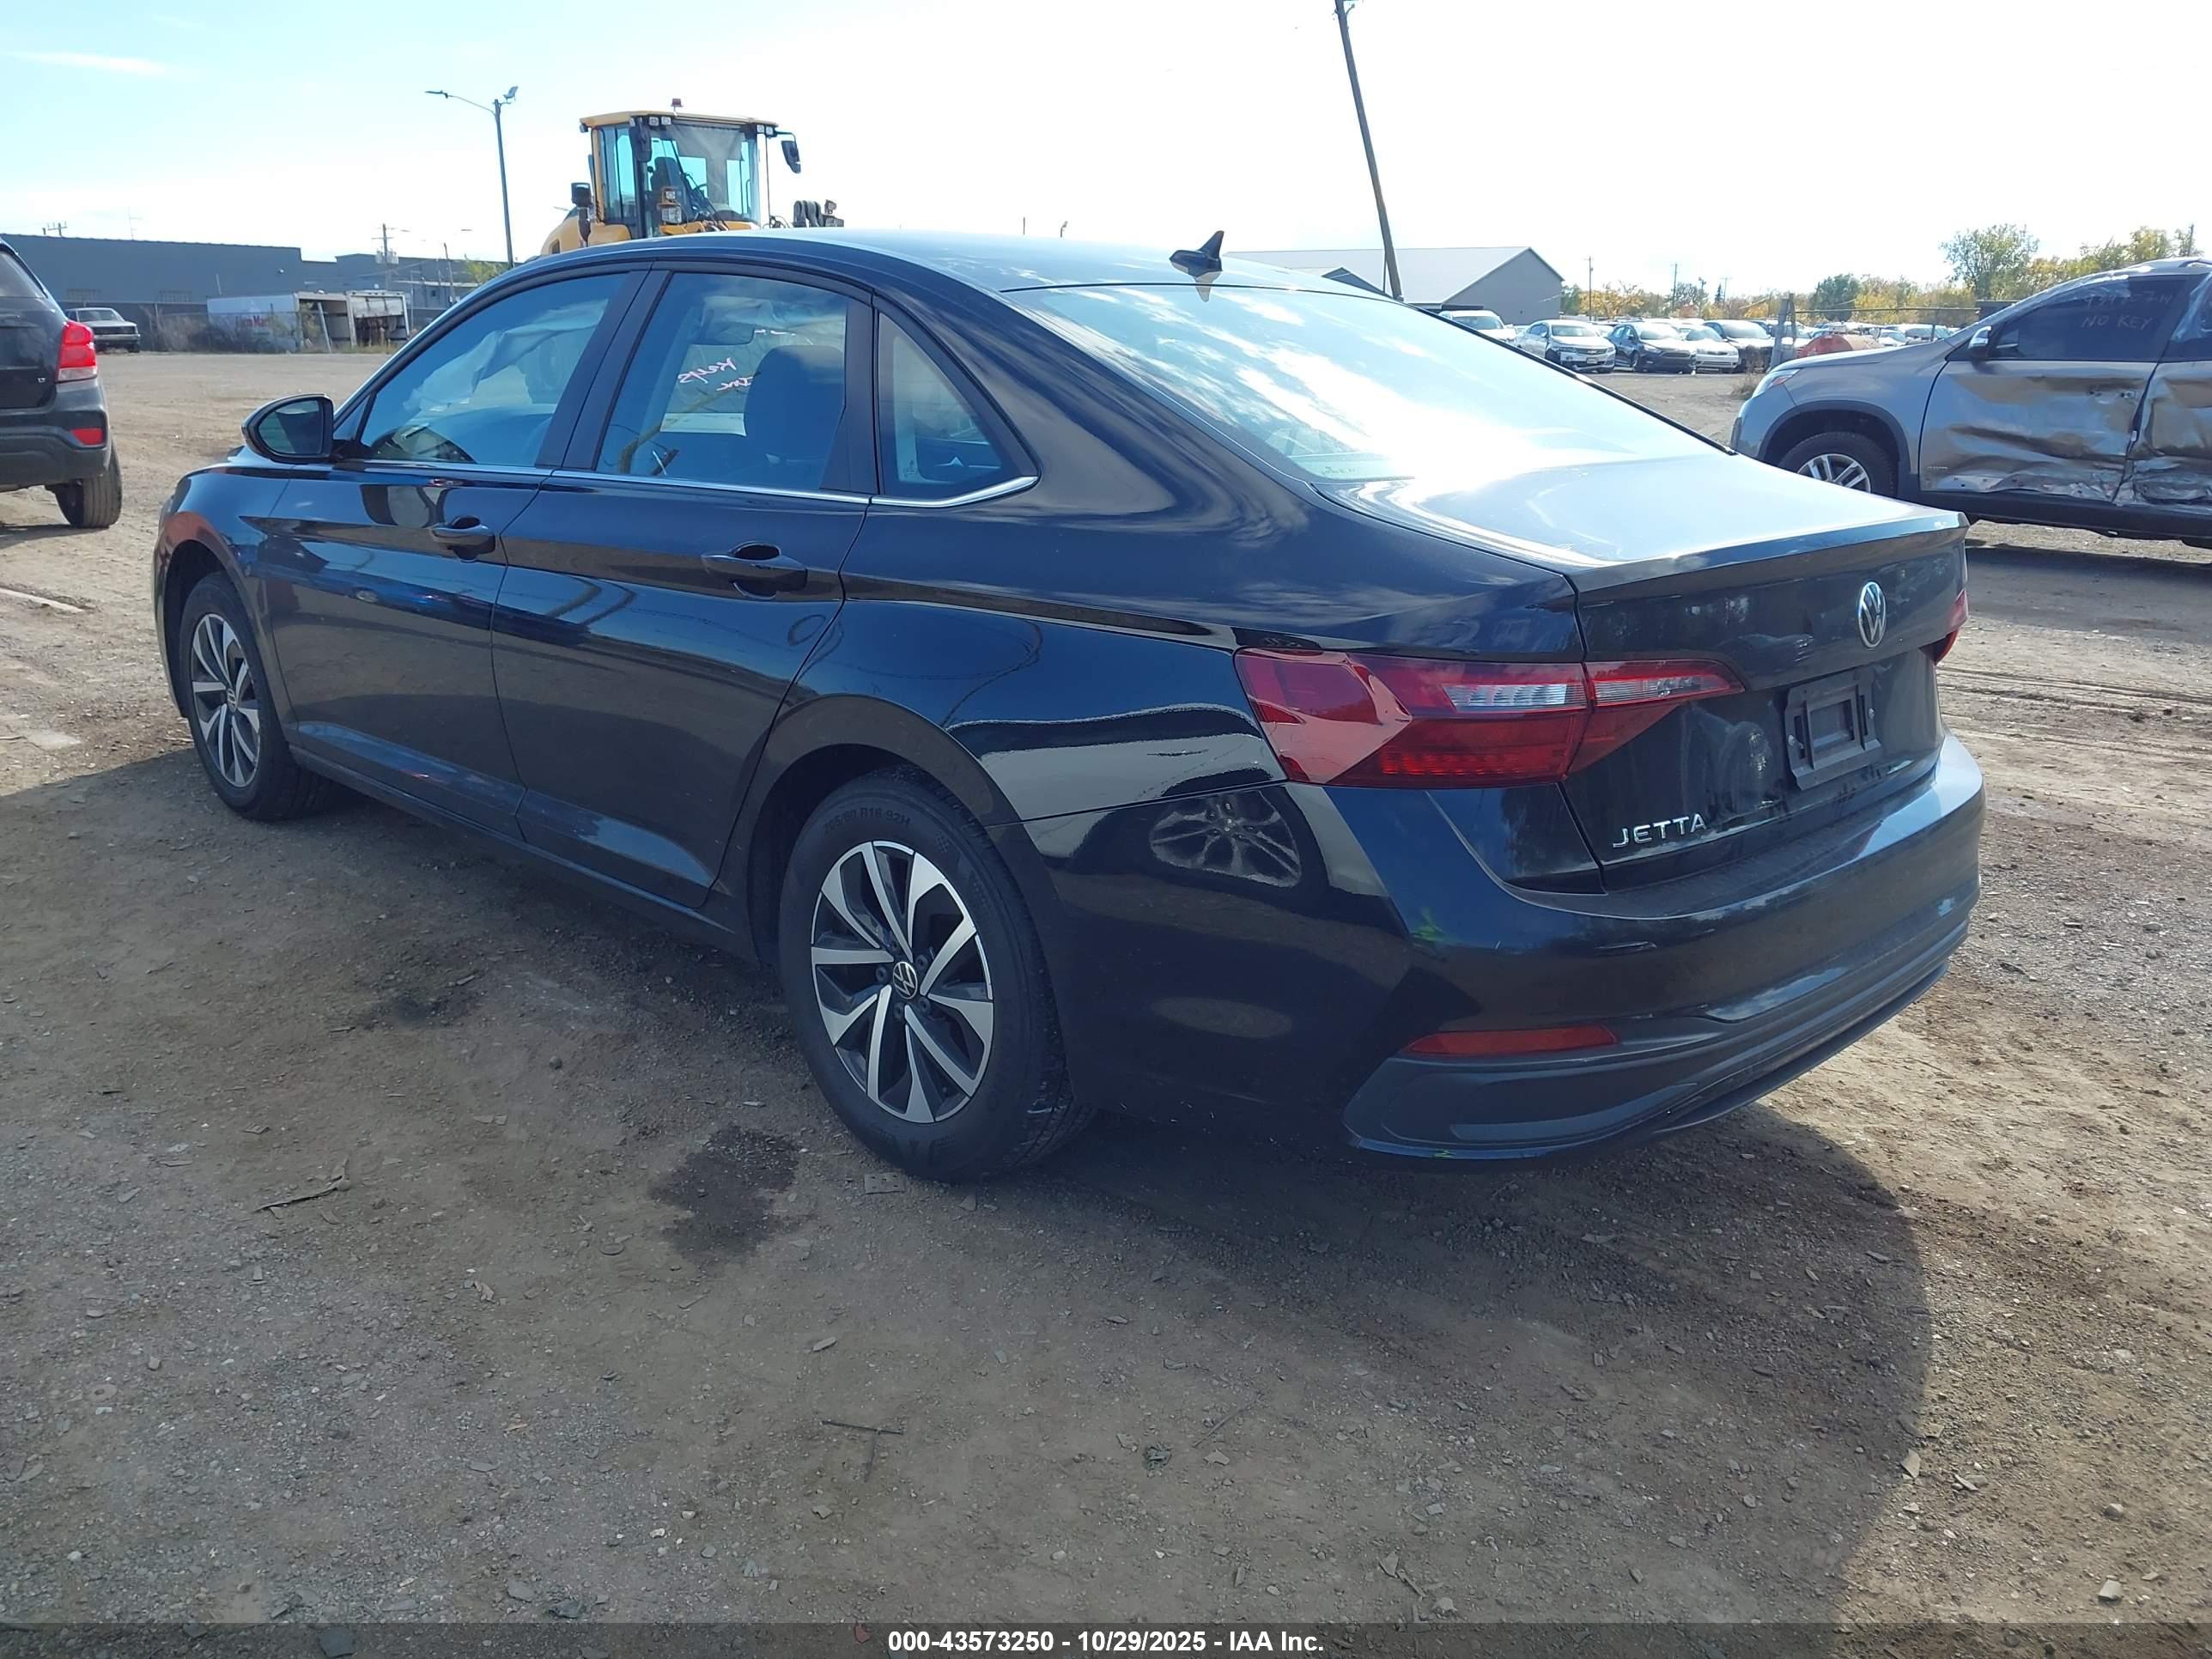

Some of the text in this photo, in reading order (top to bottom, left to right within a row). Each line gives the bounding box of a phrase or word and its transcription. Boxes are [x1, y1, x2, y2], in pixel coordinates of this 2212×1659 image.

[2081, 313, 2153, 330] NO KEY
[1613, 812, 1707, 848] JETTA
